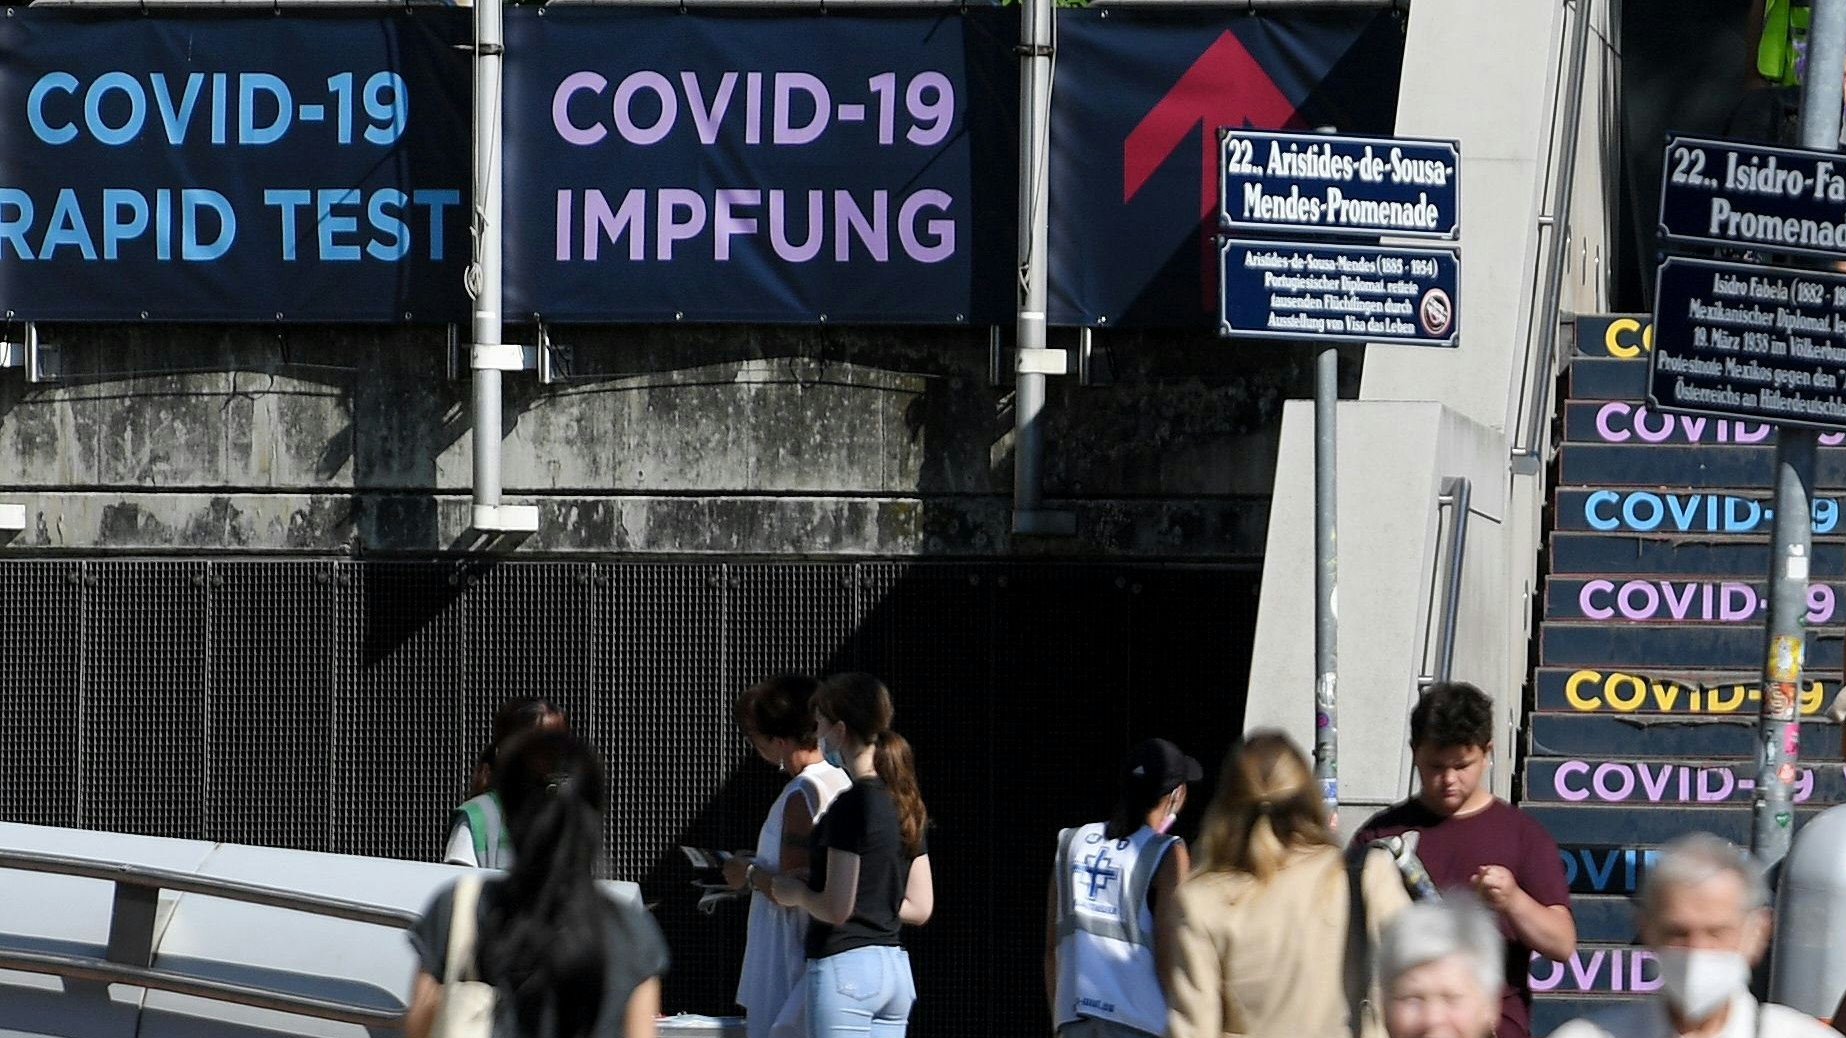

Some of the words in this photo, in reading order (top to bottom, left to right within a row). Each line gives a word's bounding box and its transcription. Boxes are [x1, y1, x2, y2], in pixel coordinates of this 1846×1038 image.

[26, 70, 410, 147] COVID-19
[551, 70, 957, 147] COVID-19
[1228, 138, 1264, 176] 22.,
[1267, 140, 1453, 186] Aristides-de-Sousa-
[1671, 147, 1719, 189] 22.,
[0, 187, 236, 262] RAPID
[264, 187, 461, 262] TEST
[556, 187, 957, 263] IMPFUNG
[1243, 182, 1439, 229] Mendes-Promenade
[1264, 271, 1340, 293] Portugiesischer
[1713, 272, 1748, 296] Isidro
[1750, 276, 1789, 300] Fabela
[1790, 277, 1825, 306] (1882
[1267, 311, 1325, 333] Ausstellung
[1326, 318, 1344, 331] von
[1345, 315, 1366, 332] Visa
[1367, 317, 1384, 333] das
[1385, 318, 1416, 334] Leben
[1324, 294, 1384, 315] Flüchtlingen
[1385, 297, 1413, 314] durch
[1689, 297, 1776, 326] Mexikanischer
[1710, 327, 1740, 350] März
[1771, 335, 1787, 355] im
[1657, 349, 1723, 376] Protestnote
[1725, 356, 1773, 381] Mexikos
[1773, 368, 1811, 389] gegen
[1813, 366, 1837, 388] den
[1675, 376, 1741, 405] Österreichs
[1742, 393, 1758, 407] an
[1584, 490, 1840, 534] COVID-9
[1579, 579, 1836, 623] COVID-9
